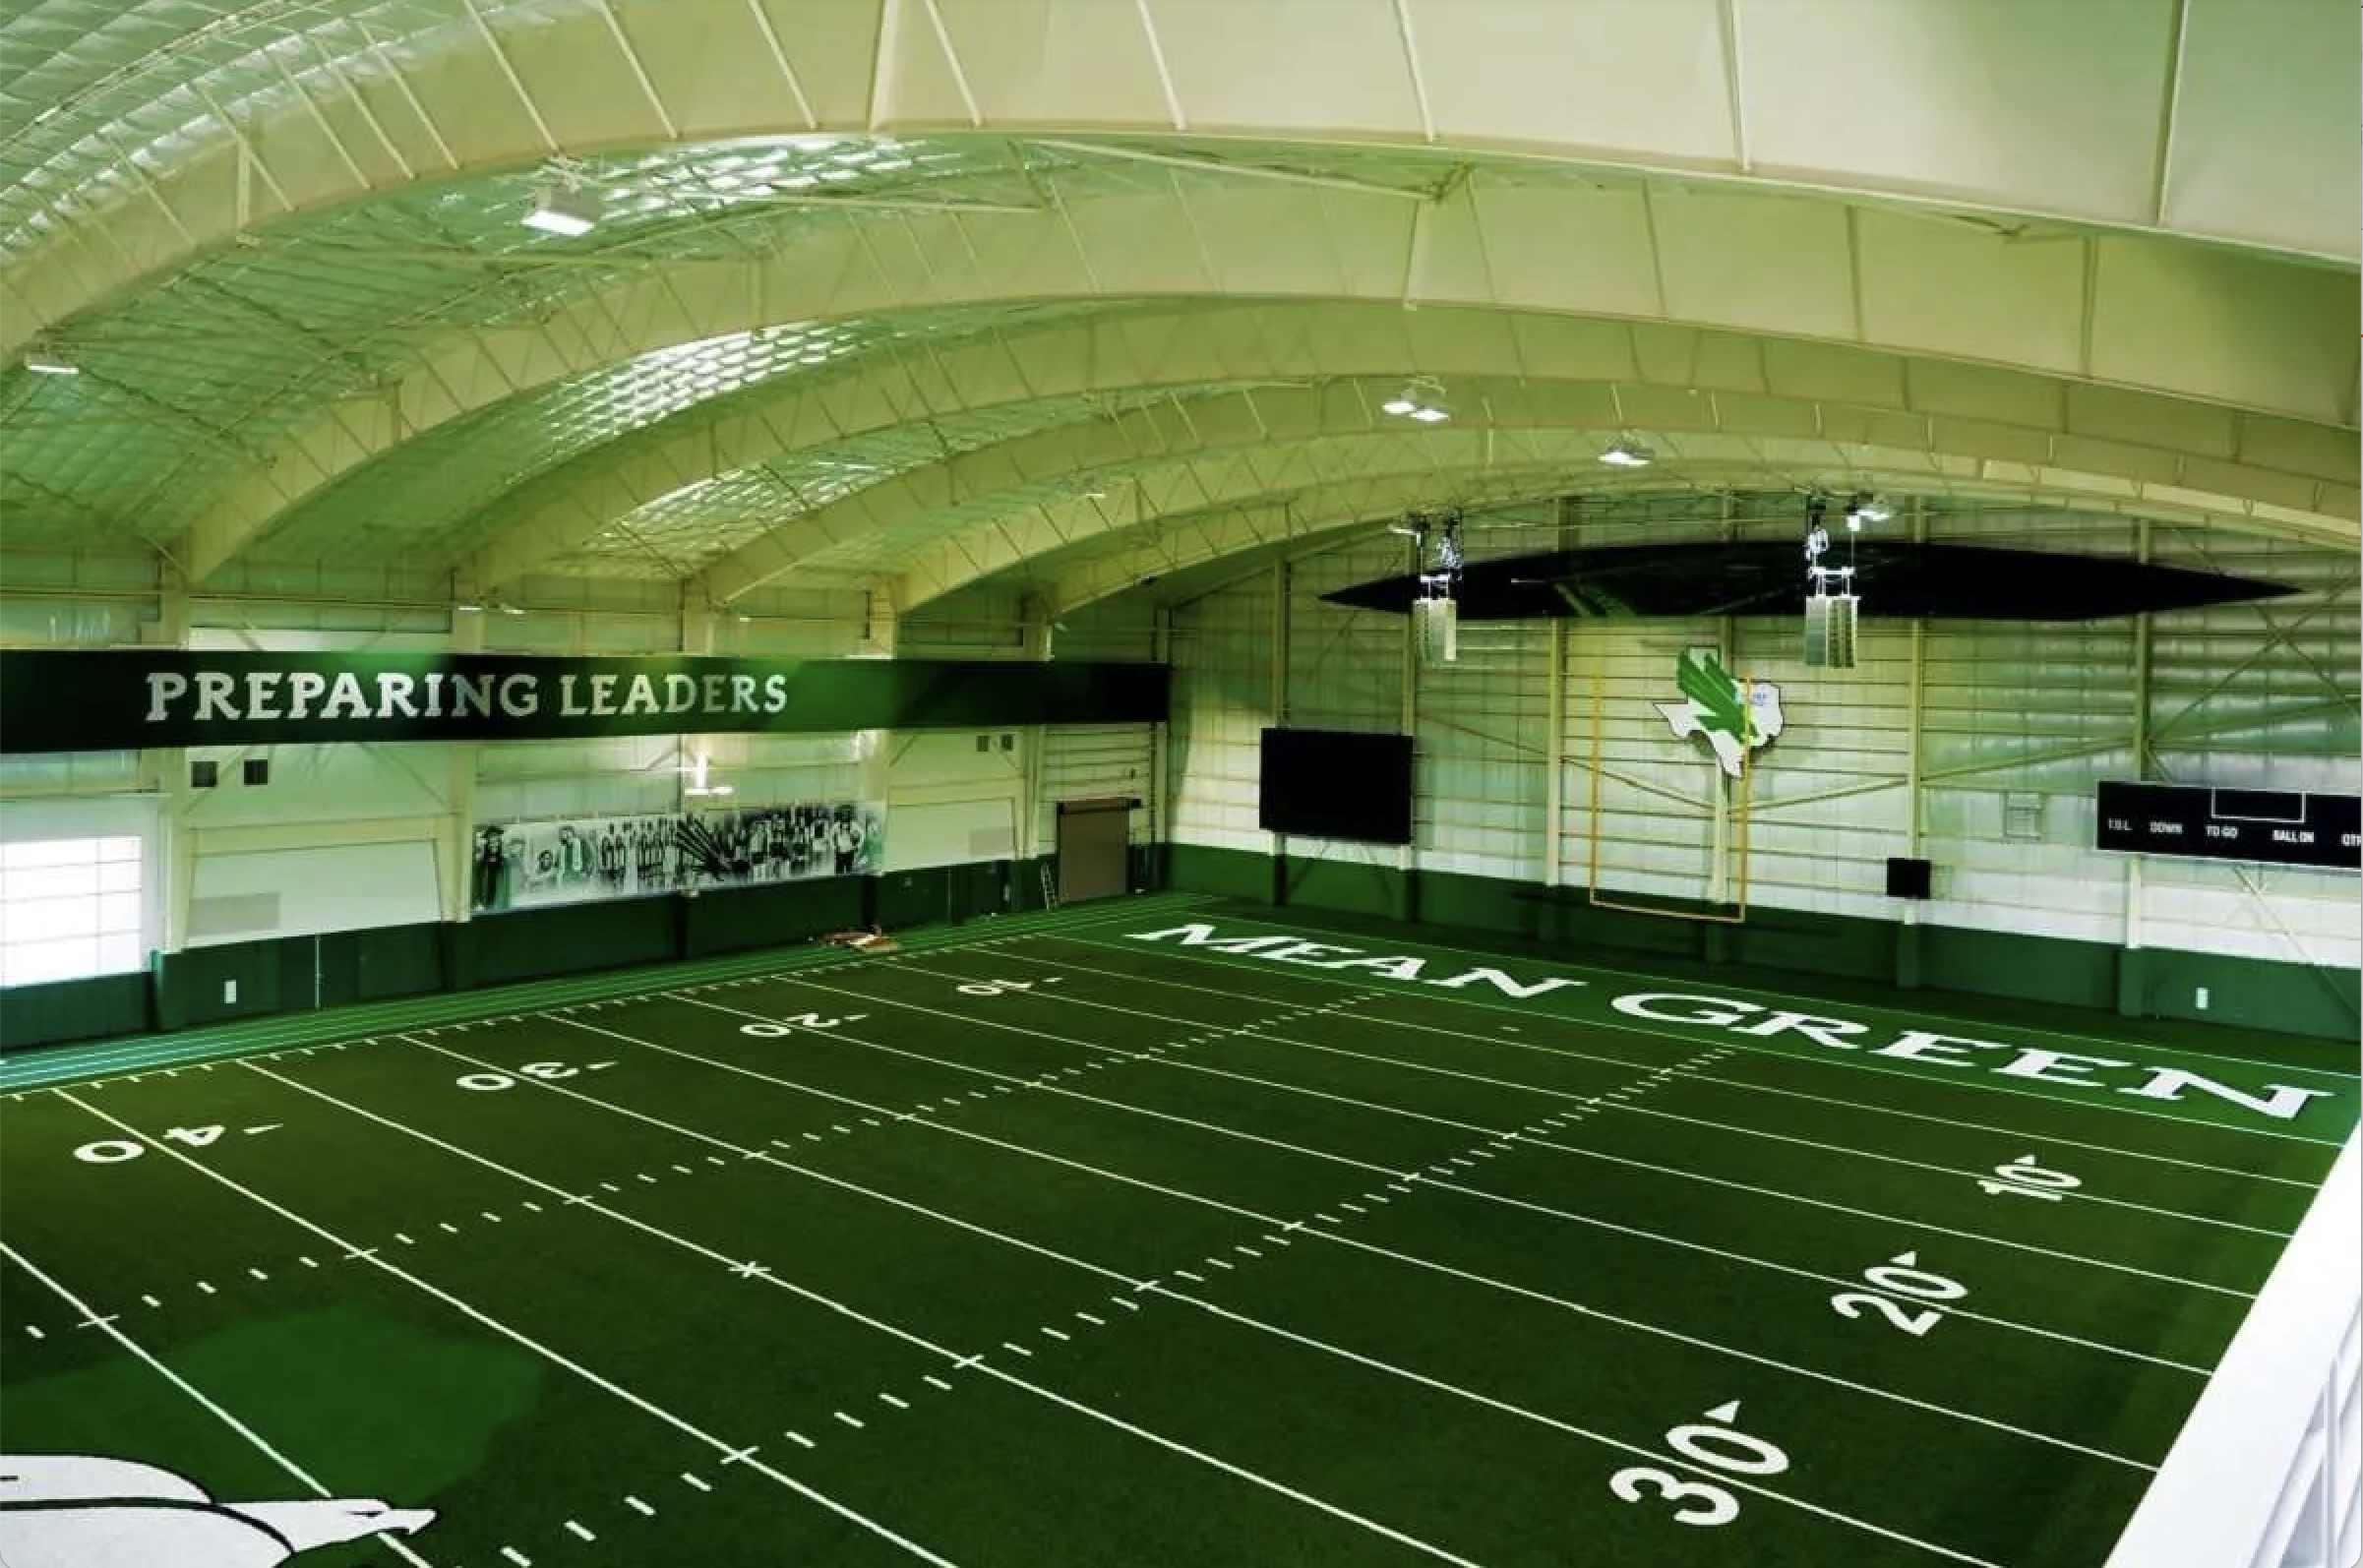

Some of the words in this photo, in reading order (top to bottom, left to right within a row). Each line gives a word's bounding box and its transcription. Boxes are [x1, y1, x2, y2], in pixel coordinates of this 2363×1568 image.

[146, 672, 539, 721] PREPARING
[559, 674, 789, 716] LEADERS
[2150, 821, 2183, 834] DOWN
[2272, 830, 2298, 843] BALL
[739, 1012, 840, 1038] 20
[1124, 923, 1586, 998] MEAN
[1609, 993, 2334, 1120] GREEN
[455, 1061, 579, 1091] 30
[73, 1124, 226, 1163] 40
[1976, 1164, 2083, 1201] 10
[1831, 1265, 1968, 1337] 20
[1608, 1423, 1789, 1527] 30
